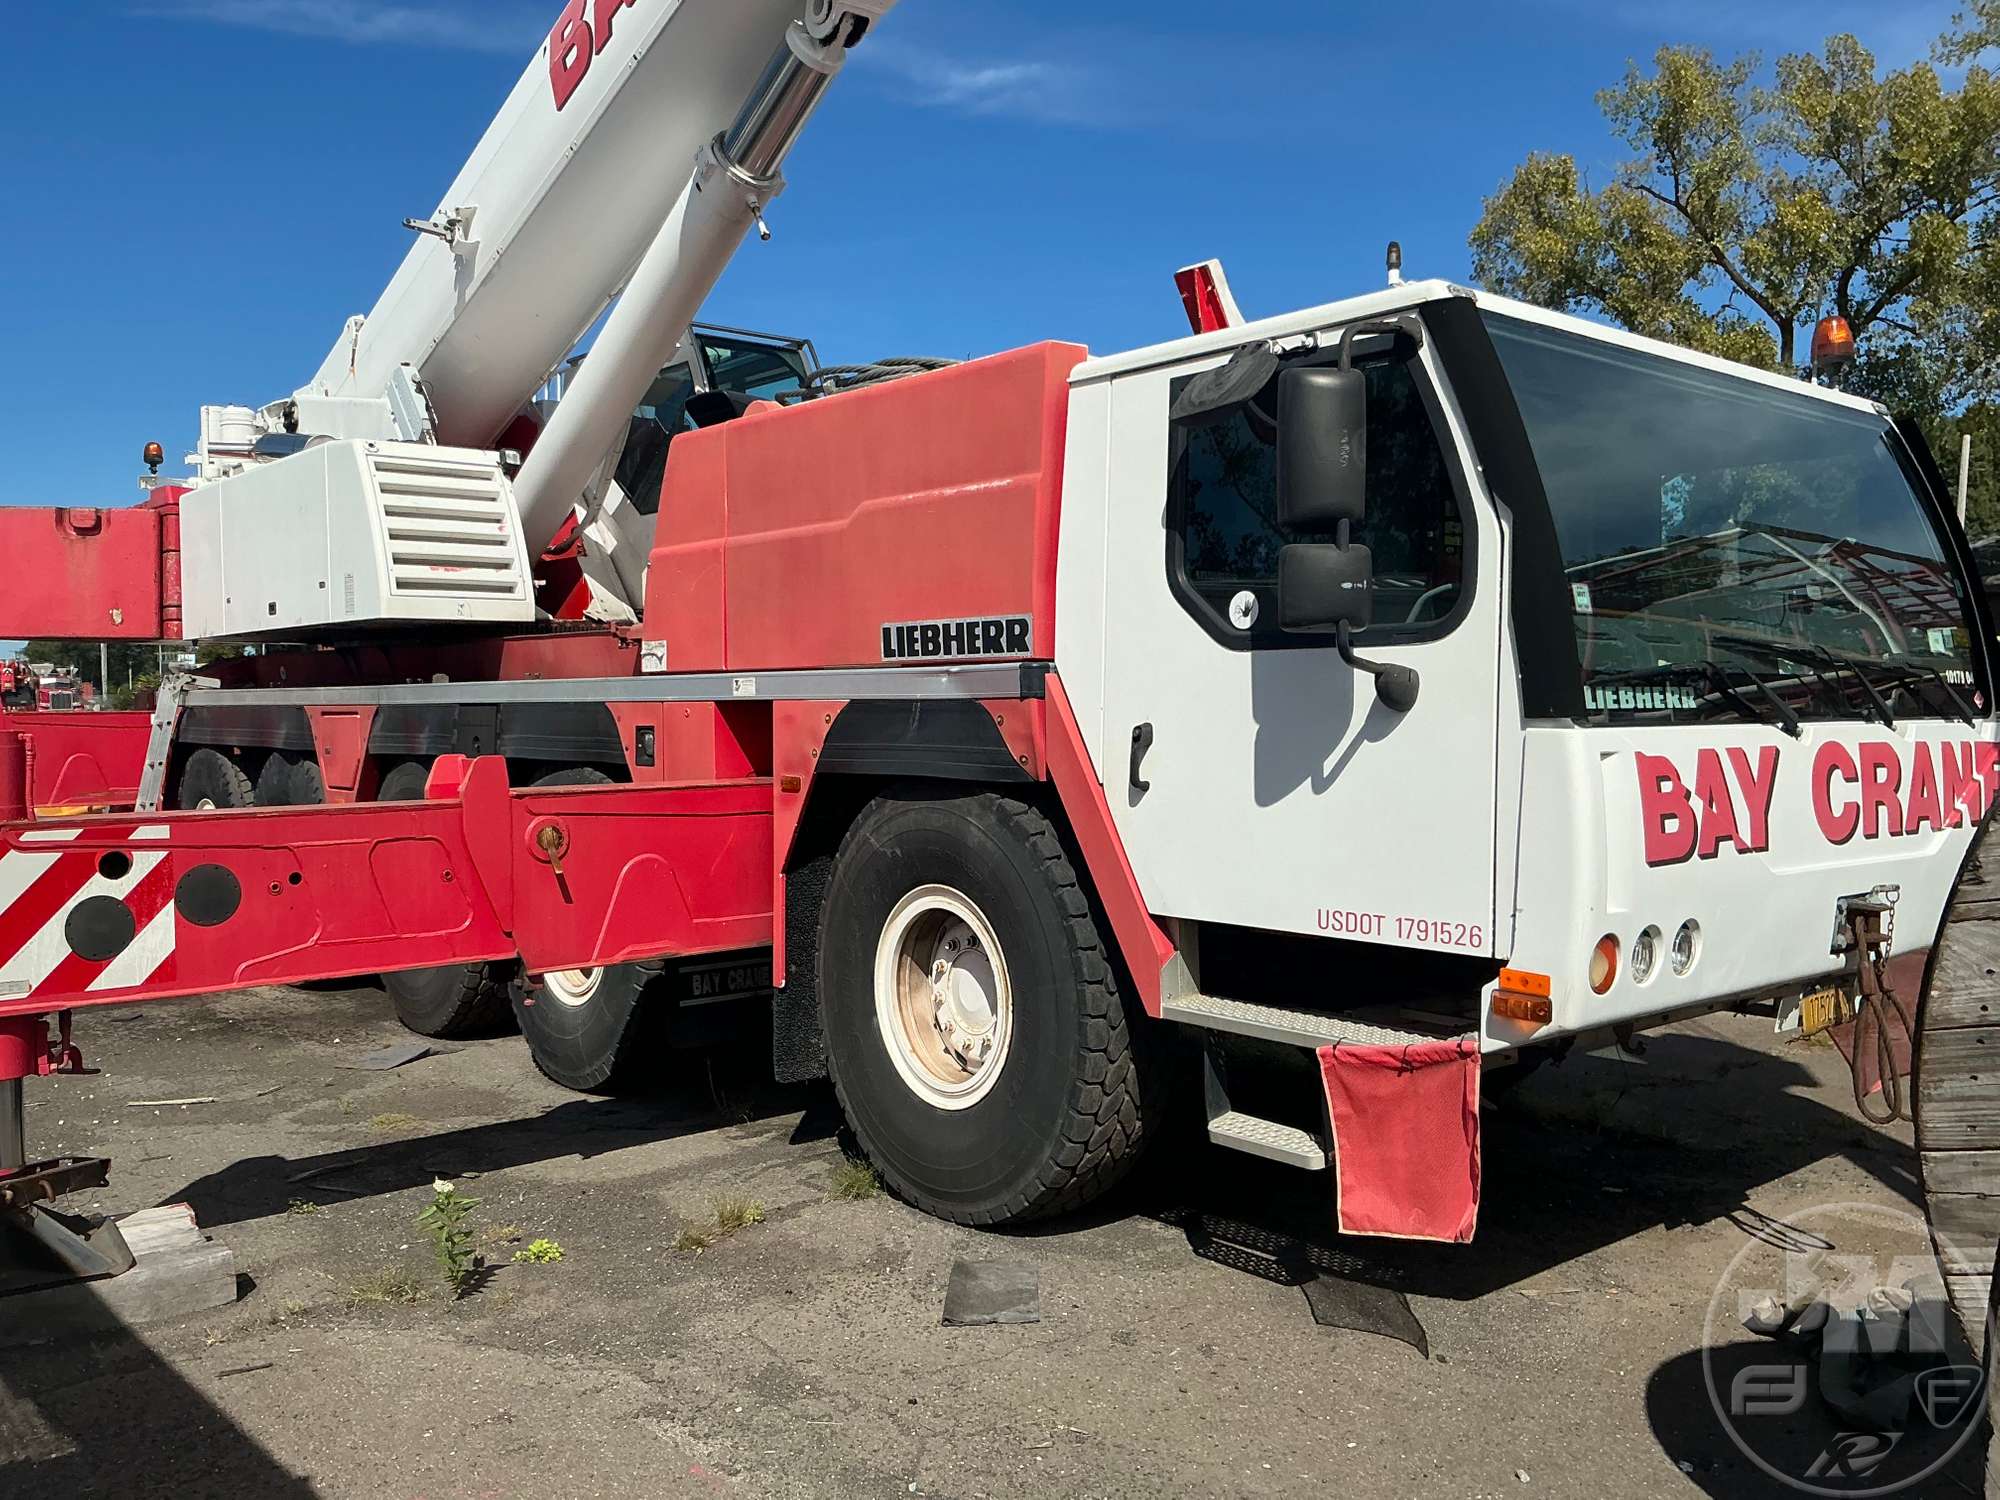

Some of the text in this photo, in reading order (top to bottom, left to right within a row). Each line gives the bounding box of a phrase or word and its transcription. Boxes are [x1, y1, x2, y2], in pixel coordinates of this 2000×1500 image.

[882, 618, 1030, 659] LIEBHERR
[1583, 685, 1697, 709] LIEBHERR
[1635, 745, 1780, 868] BAY
[1317, 908, 1482, 948] USDOT 1791526
